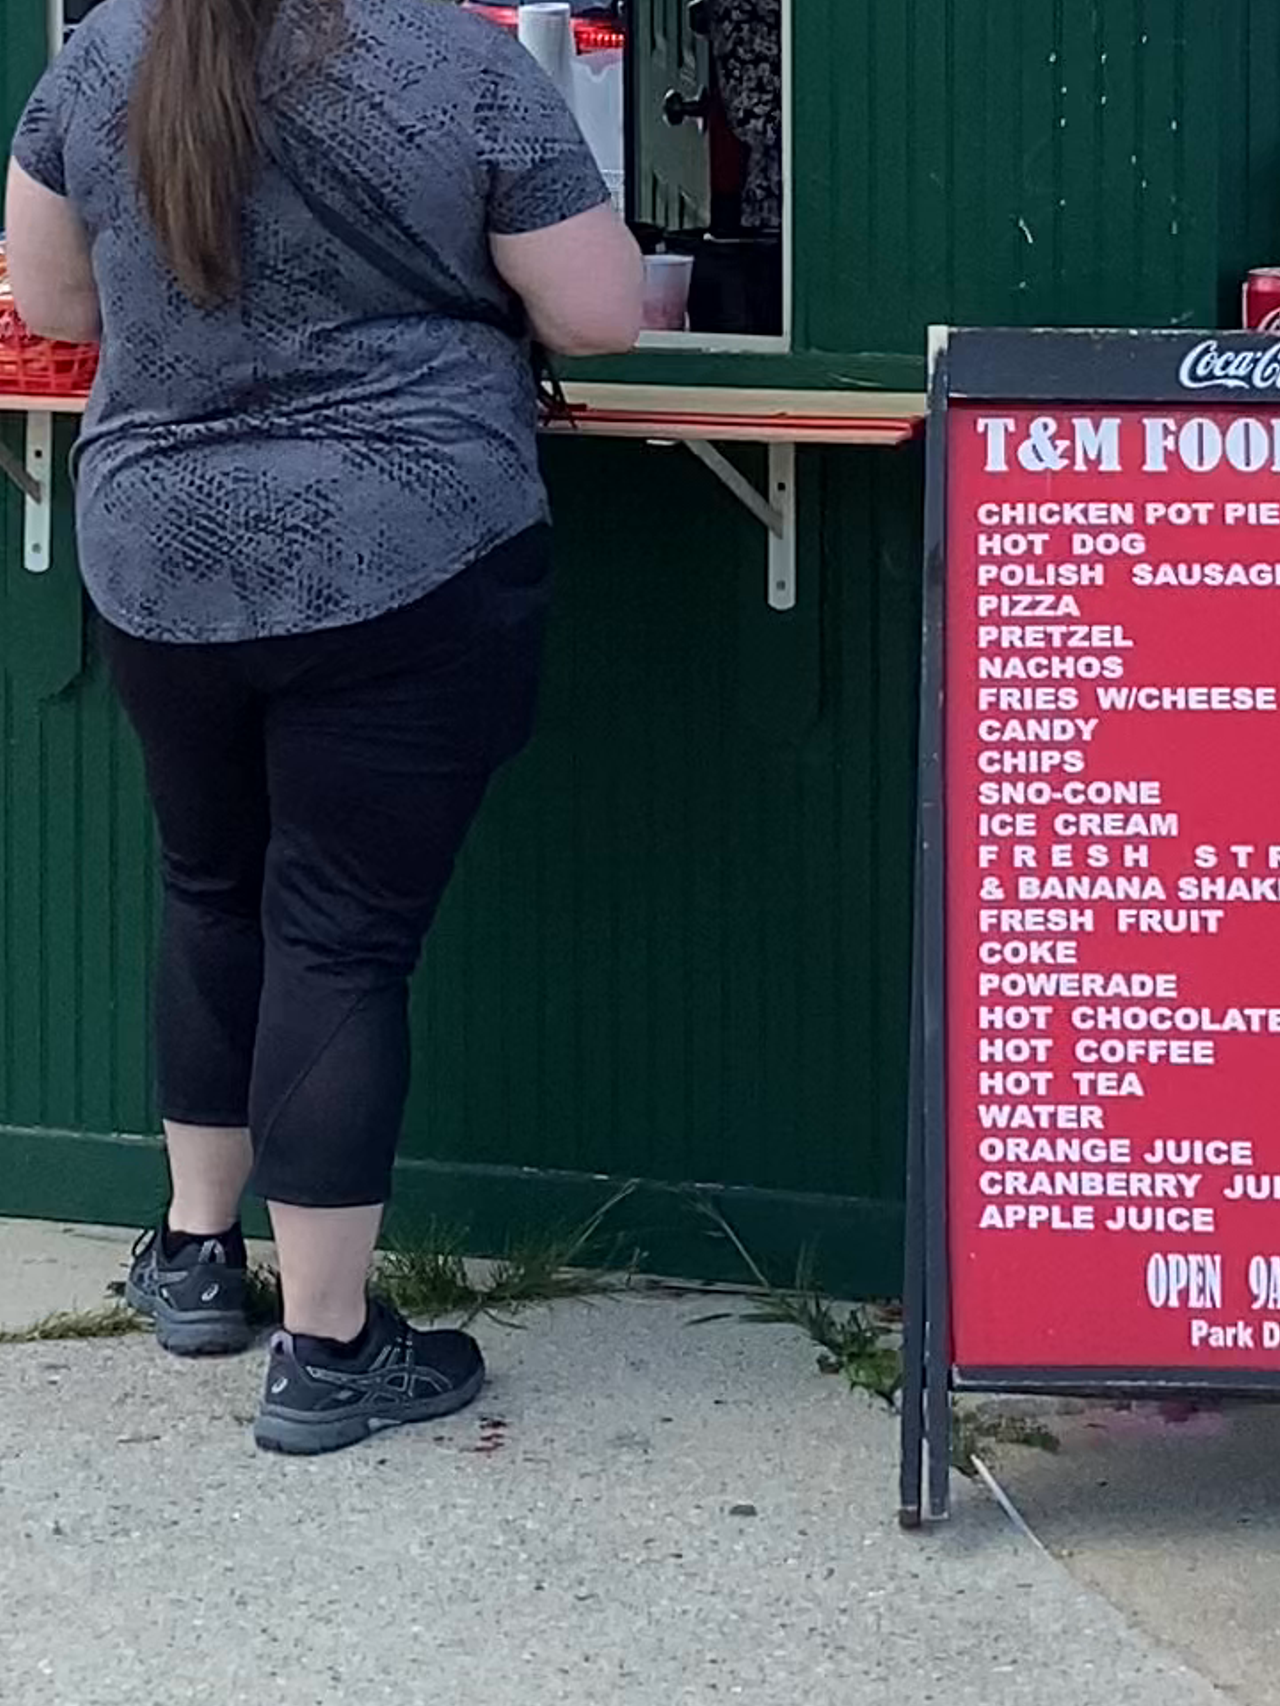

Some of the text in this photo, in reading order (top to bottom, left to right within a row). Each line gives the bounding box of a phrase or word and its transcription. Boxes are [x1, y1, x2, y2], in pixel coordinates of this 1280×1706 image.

[976, 416, 1122, 472] T&M
[977, 502, 1134, 526] CHICKEN
[1145, 502, 1215, 525] POT
[1225, 502, 1280, 525] PIE
[978, 533, 1050, 556] HOT
[1072, 532, 1146, 555] DOG
[978, 563, 1104, 587] POLISH
[978, 594, 1081, 618] PIZZA
[978, 624, 1134, 649] PRETZEL
[978, 655, 1124, 679] NACHOS
[978, 687, 1079, 711] FRIES
[1096, 686, 1277, 710] W/CHEESE
[978, 718, 1099, 742] CANDY
[978, 750, 1085, 774] CHIPS
[978, 780, 1161, 805] SNO-CONE
[979, 813, 1037, 837] ICE
[1054, 813, 1178, 837] CREAM
[979, 843, 1149, 868] FRESH
[979, 876, 1005, 900] &
[1018, 876, 1167, 900] BANANA
[979, 908, 1094, 933] FRESH
[1118, 908, 1224, 933] FRUIT
[979, 940, 1078, 965] COKE
[979, 972, 1178, 998] POWERADE
[979, 1005, 1053, 1030] HOT
[979, 1038, 1053, 1063] HOT
[1075, 1038, 1215, 1065] COFFEE
[979, 1071, 1054, 1096] HOT
[1072, 1072, 1144, 1097] TEA
[977, 1104, 1104, 1129] WATER
[979, 1137, 1131, 1163] ORANGE
[1143, 1139, 1253, 1166] JUICE
[979, 1170, 1202, 1198] CRANBERRY
[979, 1204, 1095, 1230] APPLE
[1105, 1206, 1215, 1232] JUICE
[1146, 1252, 1222, 1309] OPEN
[1191, 1319, 1254, 1348] Park
